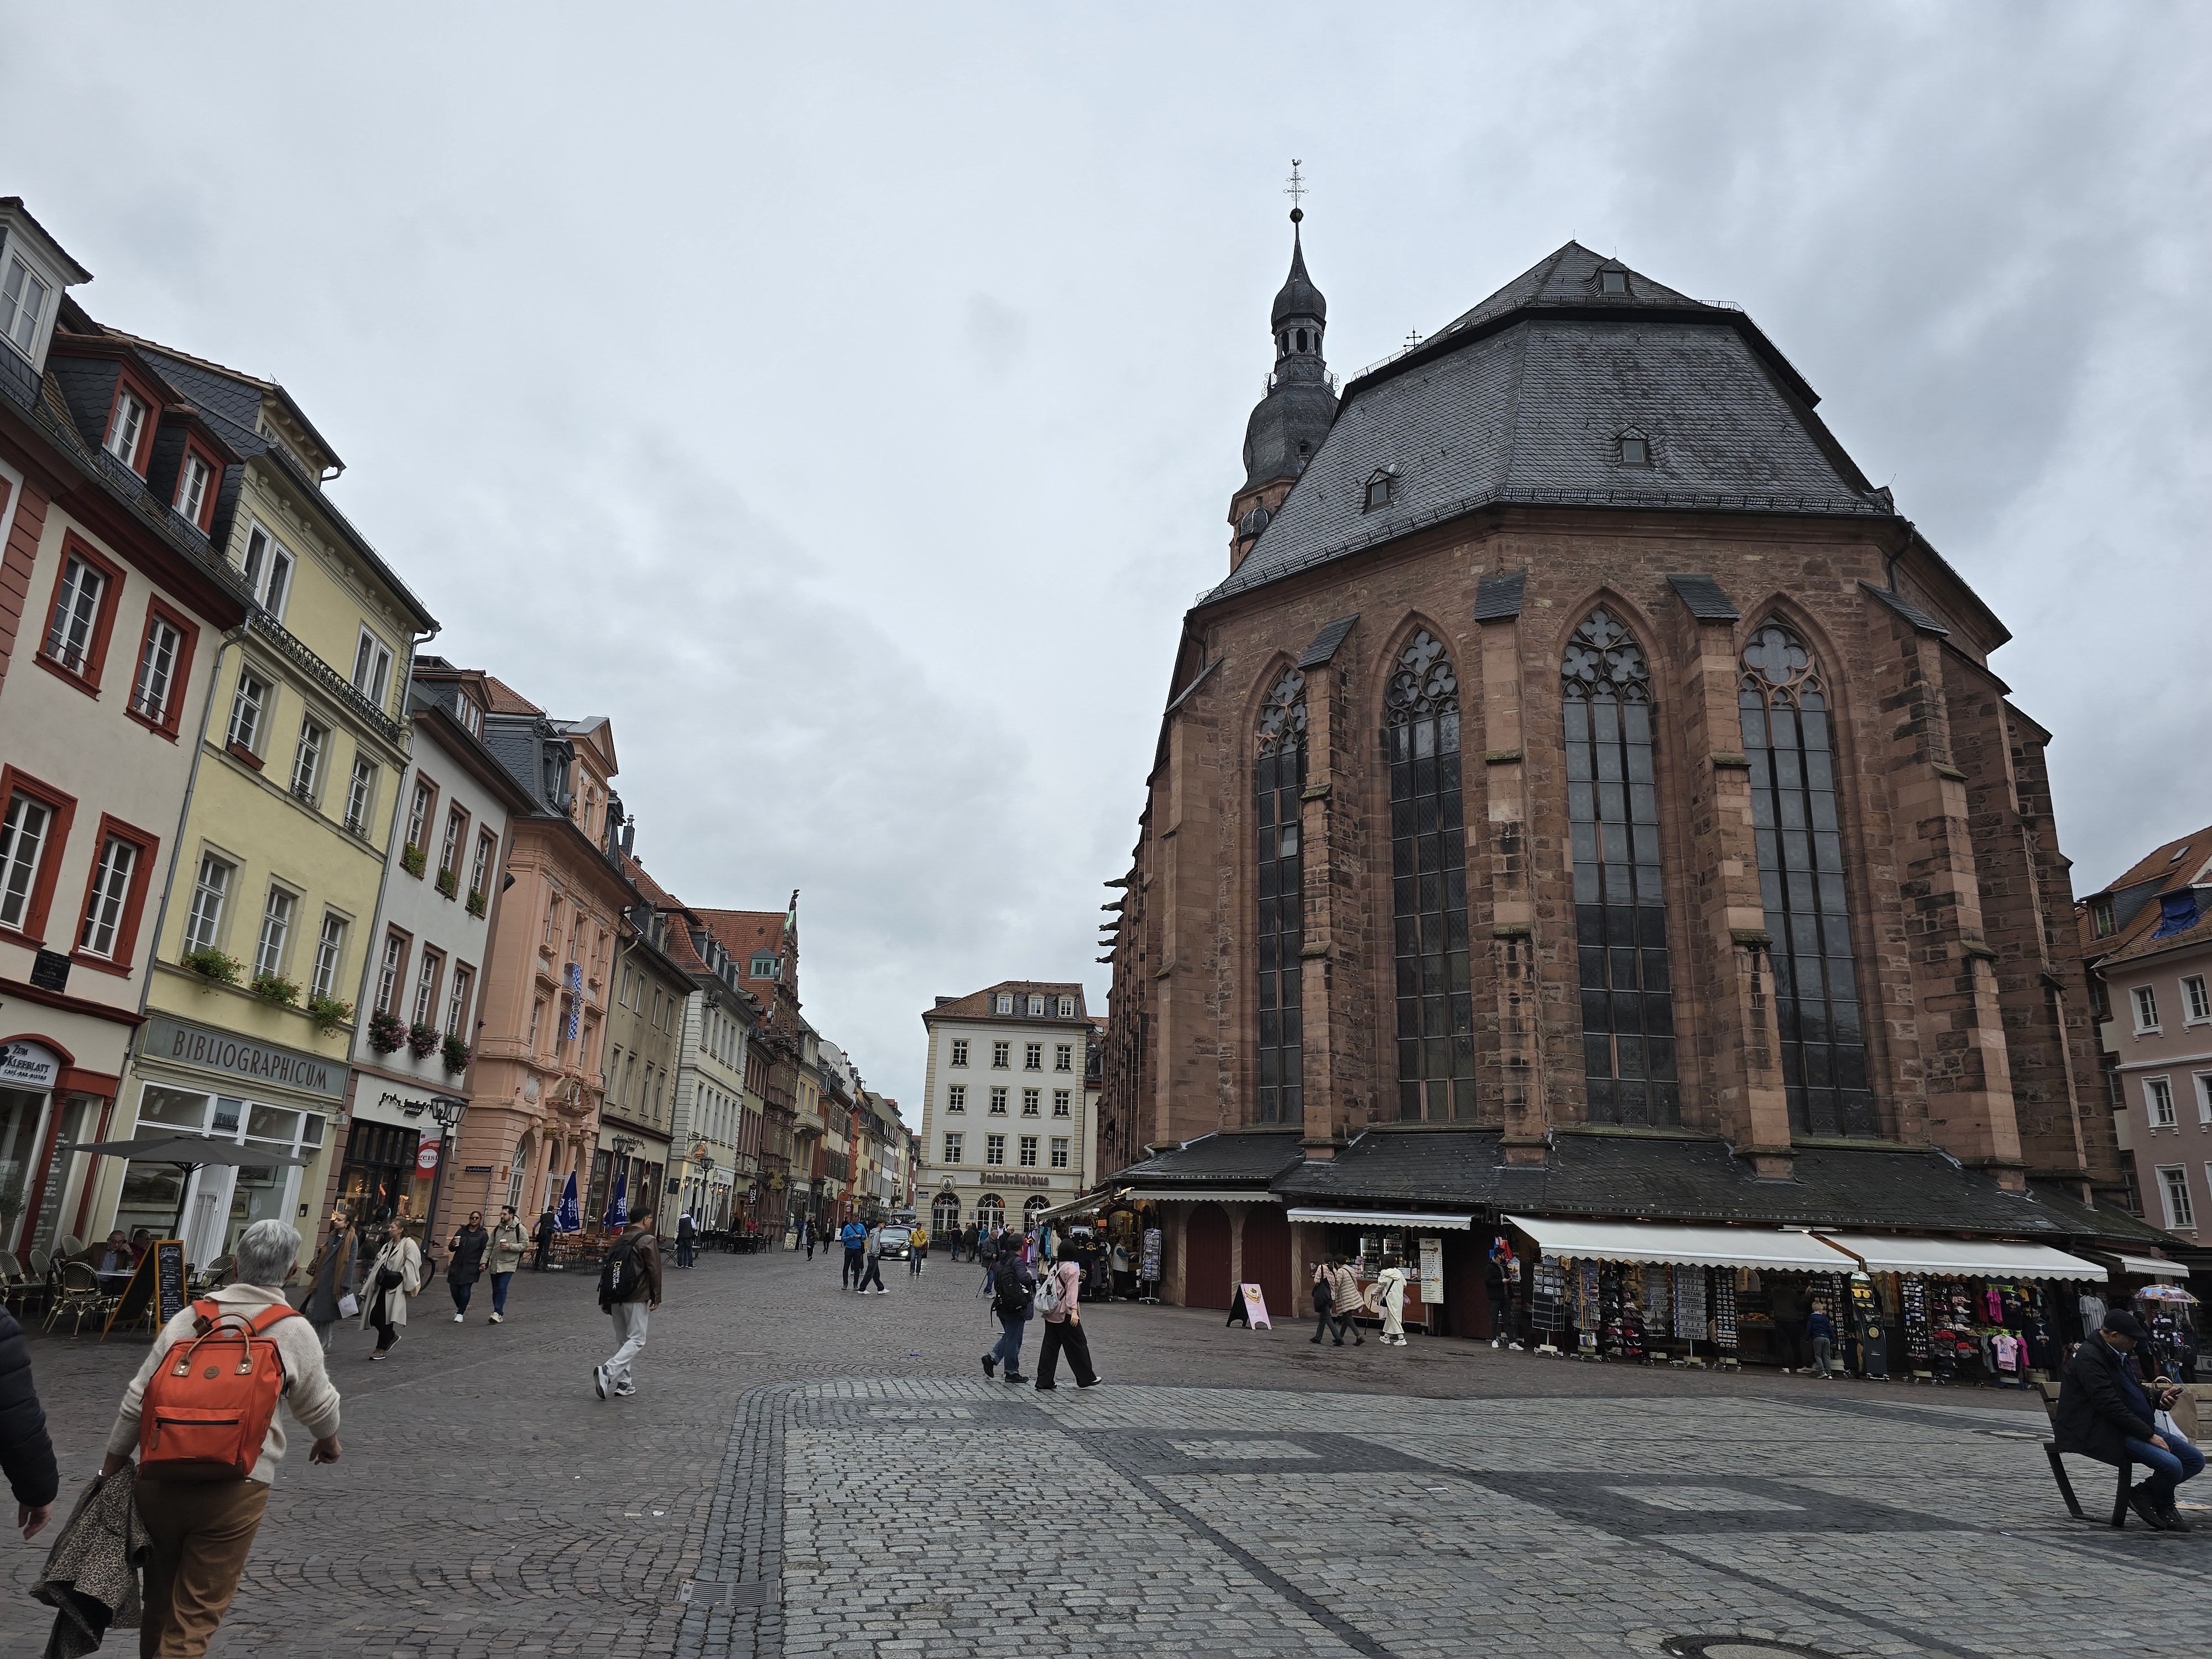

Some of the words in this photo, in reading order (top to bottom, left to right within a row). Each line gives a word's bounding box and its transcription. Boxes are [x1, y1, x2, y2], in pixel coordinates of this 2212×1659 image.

[6, 1055, 50, 1073] KLEEBLATT
[172, 1030, 326, 1089] BIBLIOGRAPHICUM
[418, 1154, 437, 1162] geist
[980, 1172, 1049, 1186] Palmbräuhaus
